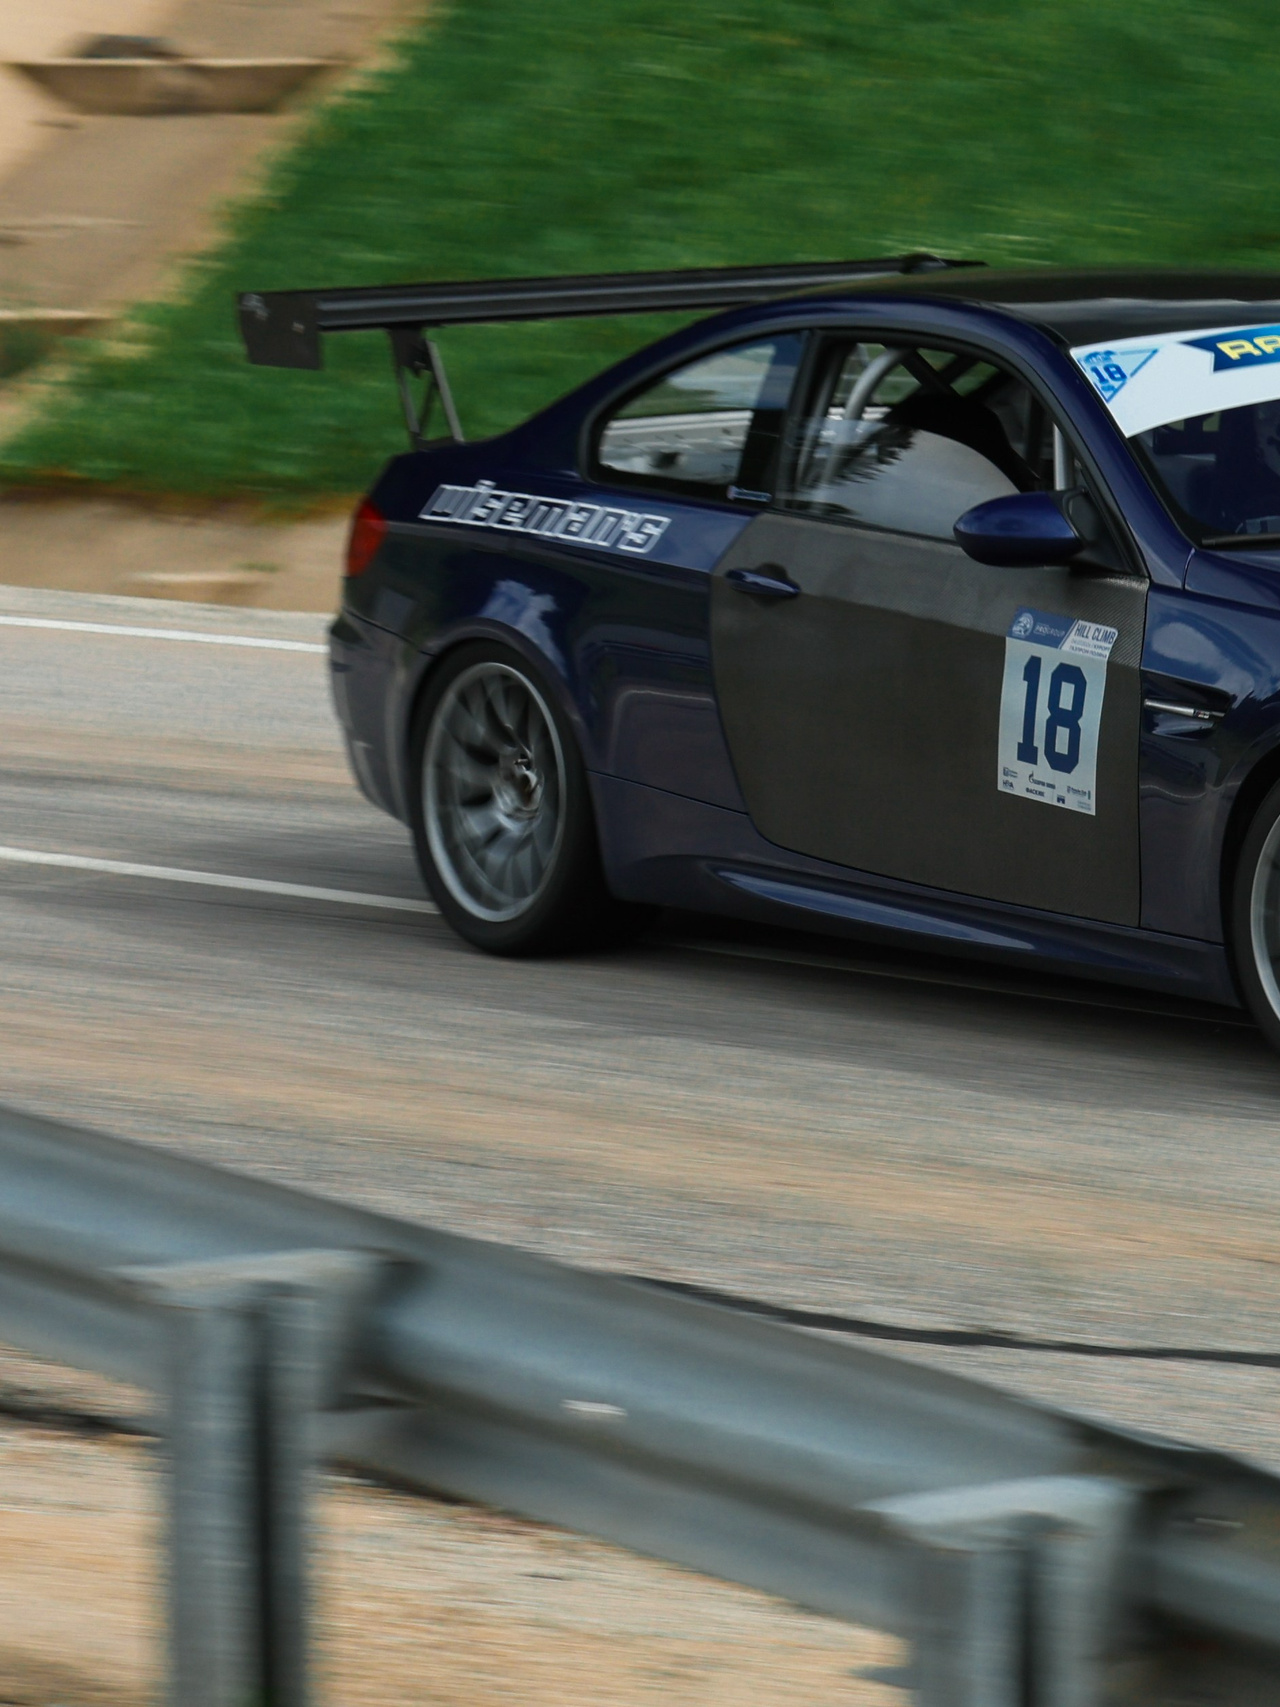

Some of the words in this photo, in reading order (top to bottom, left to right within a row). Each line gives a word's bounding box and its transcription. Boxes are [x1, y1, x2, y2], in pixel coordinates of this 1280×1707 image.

[1090, 363, 1128, 384] 18
[1074, 623, 1092, 639] HILL
[1091, 626, 1117, 645] CLIMB
[1017, 655, 1087, 774] 18
